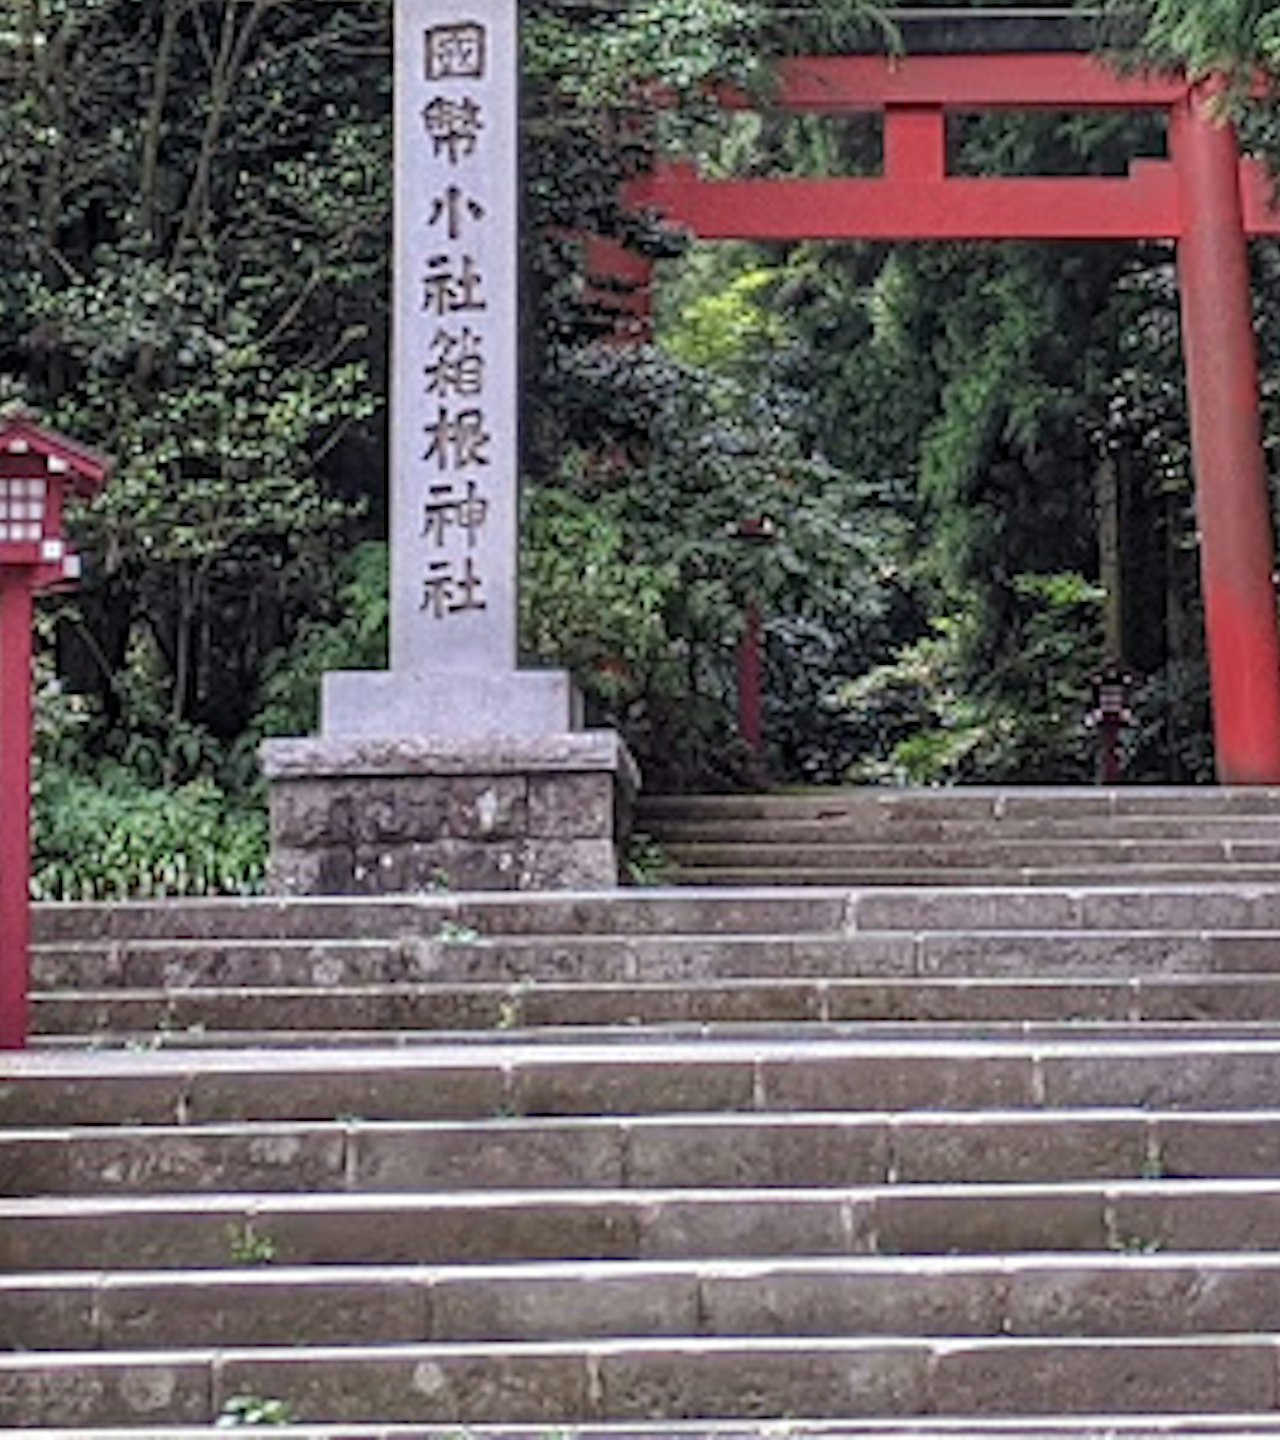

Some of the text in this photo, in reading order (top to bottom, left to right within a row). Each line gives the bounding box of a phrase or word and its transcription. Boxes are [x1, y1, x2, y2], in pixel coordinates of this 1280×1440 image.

[420, 21, 490, 619] 國幣小社箱根神社
